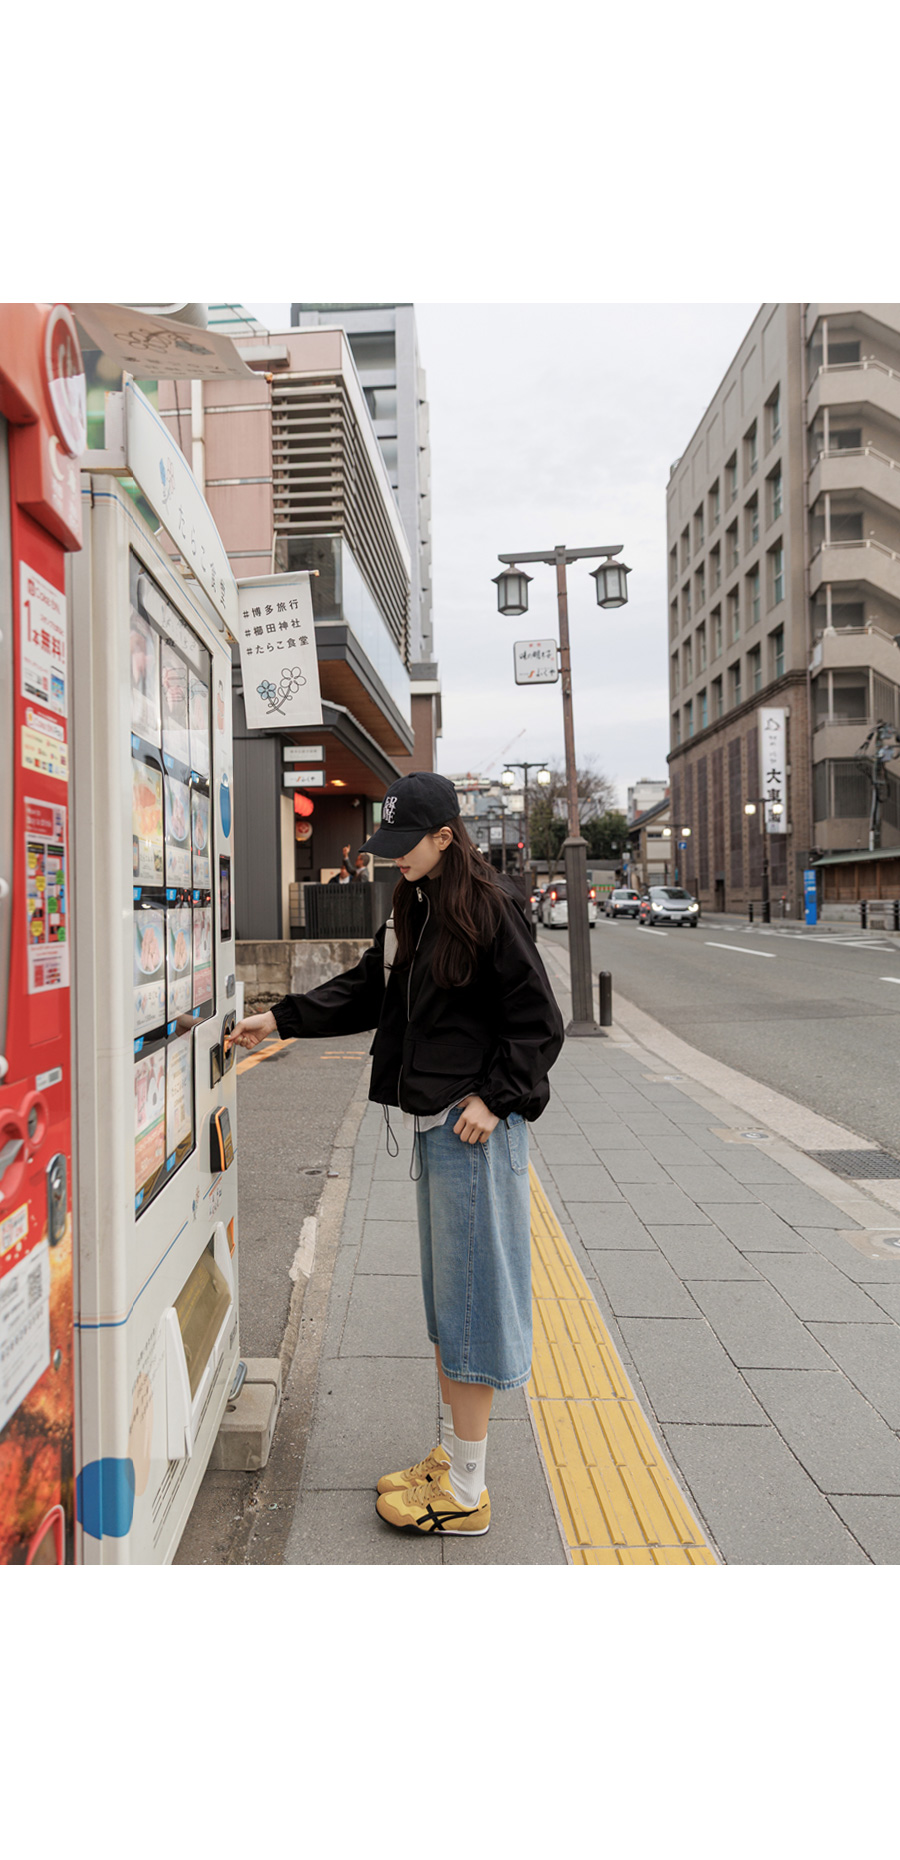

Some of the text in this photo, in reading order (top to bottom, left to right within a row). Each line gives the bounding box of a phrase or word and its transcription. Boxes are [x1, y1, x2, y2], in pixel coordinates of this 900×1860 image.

[242, 598, 299, 619] #博多旅行
[244, 618, 301, 637] #櫛田神社
[246, 635, 309, 655] #たらこ食堂
